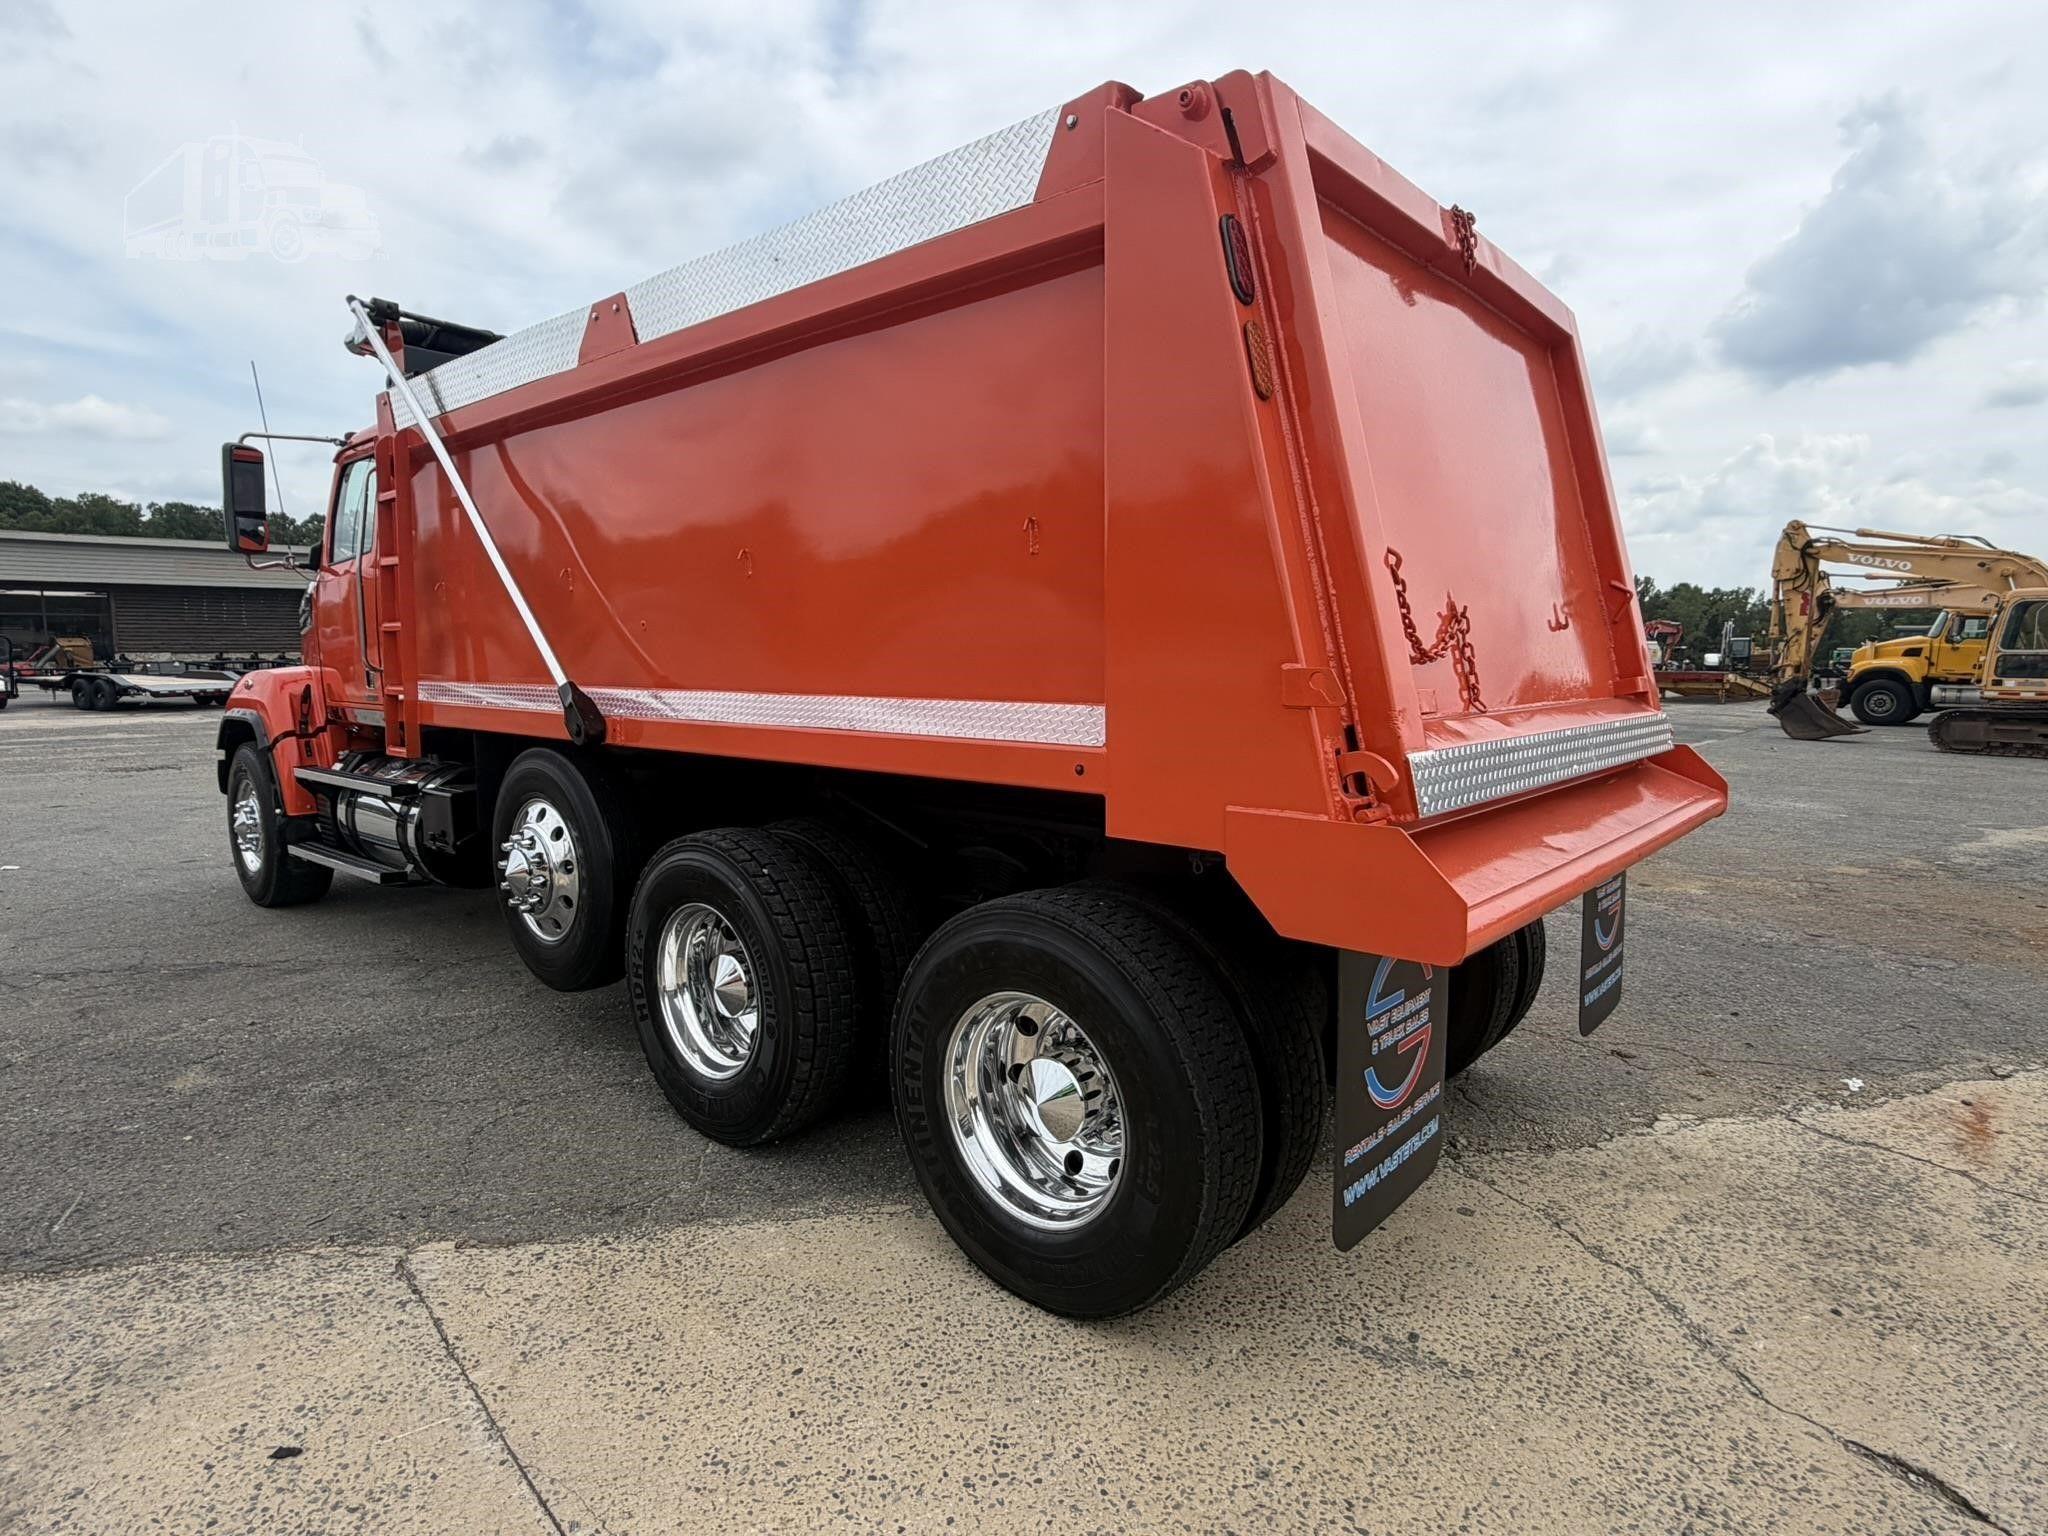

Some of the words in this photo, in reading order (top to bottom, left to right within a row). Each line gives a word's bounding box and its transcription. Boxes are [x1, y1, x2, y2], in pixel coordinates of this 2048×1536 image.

[1847, 553, 1912, 571] VOLVO
[1863, 596, 1923, 605] VOLVO
[1366, 1012, 1391, 1037] VAST
[1390, 987, 1432, 1024] EQUIPMENT
[1379, 1022, 1406, 1050] TRUCK
[1405, 1007, 1429, 1034] SALES
